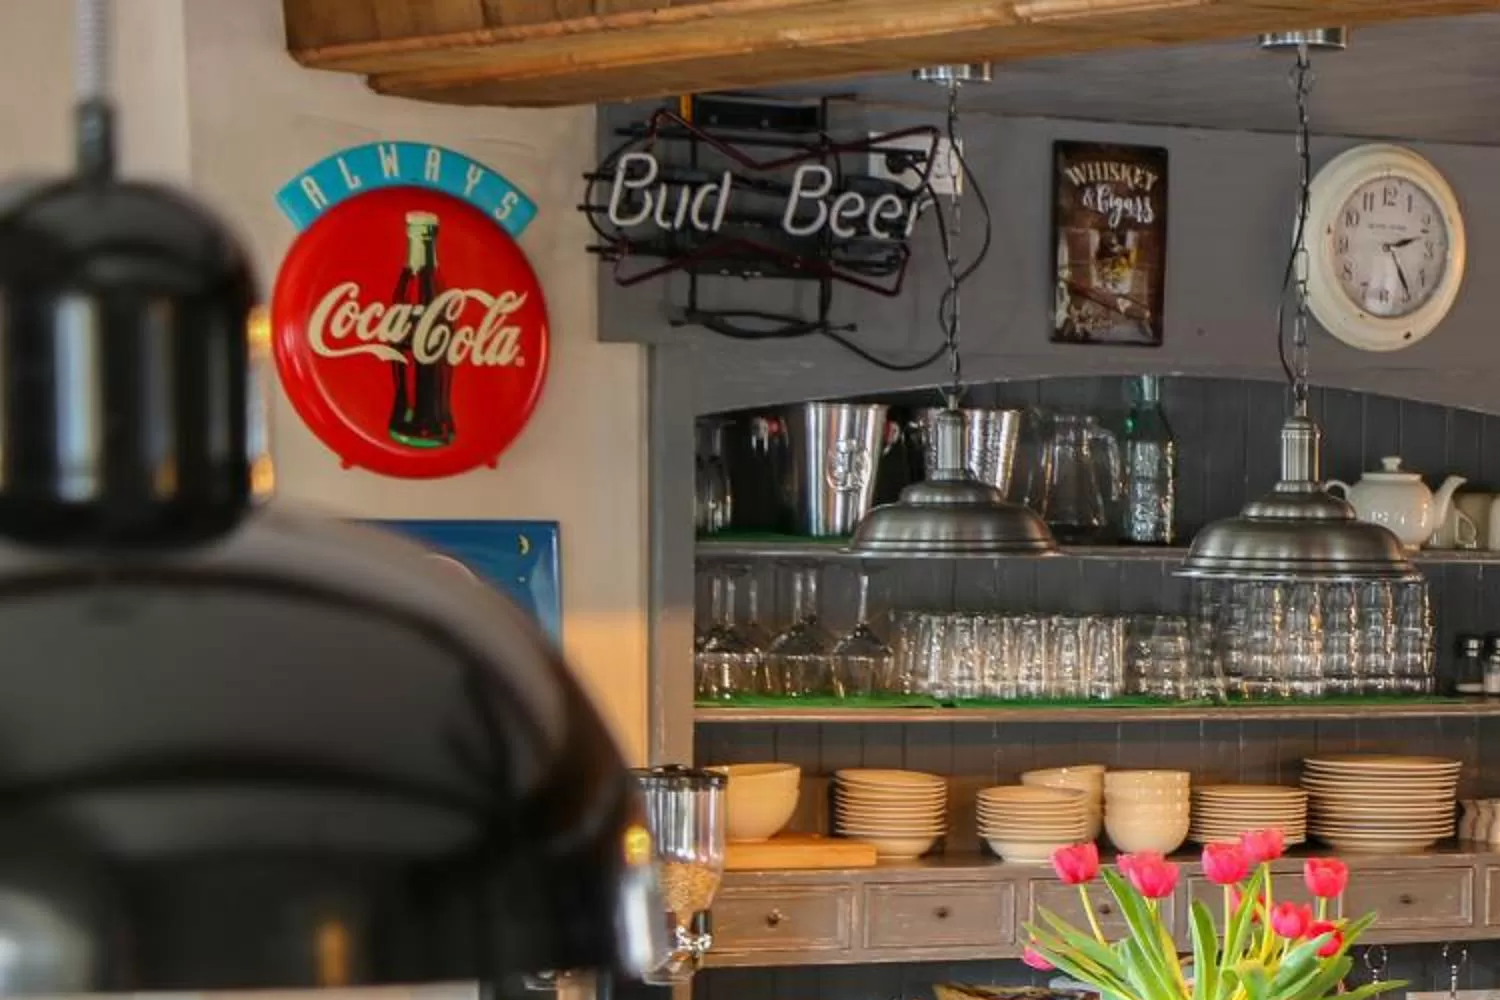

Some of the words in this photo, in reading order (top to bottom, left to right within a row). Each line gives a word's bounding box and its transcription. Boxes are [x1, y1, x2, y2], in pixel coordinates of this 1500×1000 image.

[300, 143, 519, 221] ALWAYS
[607, 151, 732, 231] Bud
[782, 165, 932, 240] Beer
[1064, 161, 1158, 191] WHISKEY
[307, 281, 529, 368] Coca-Cola
